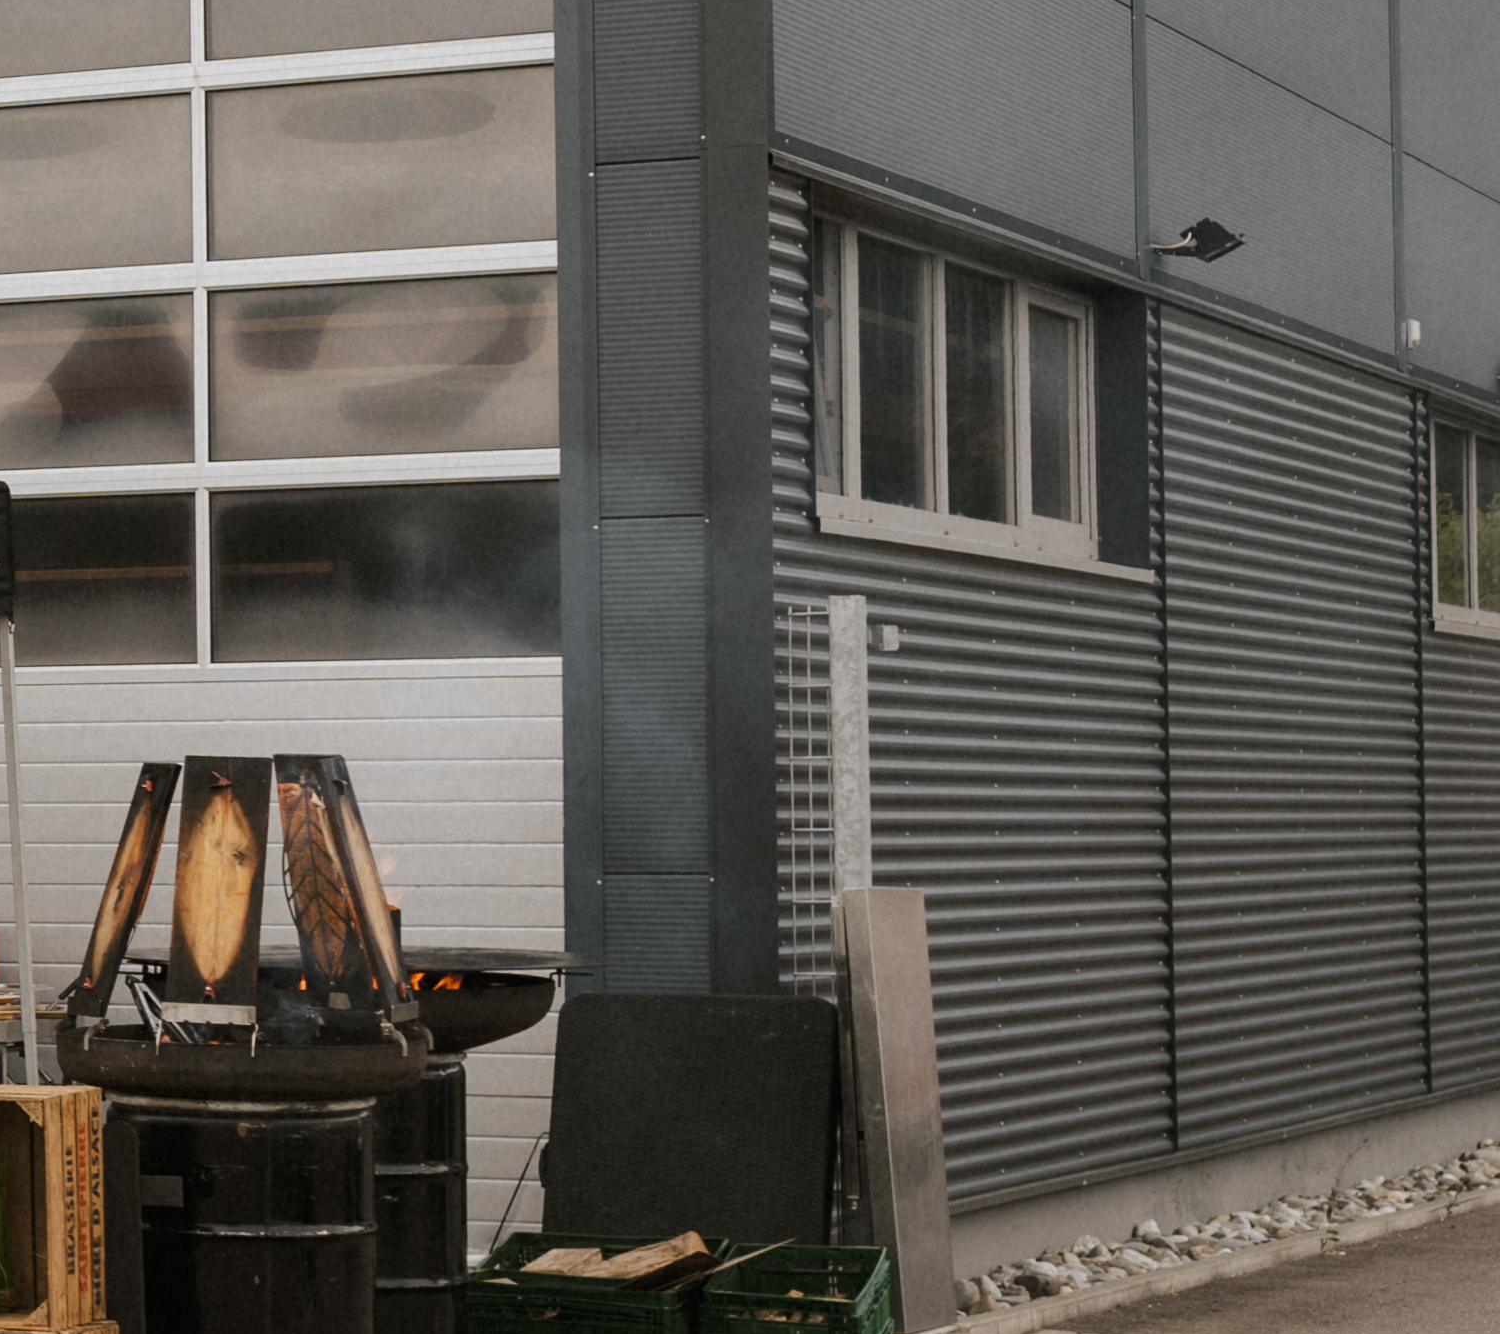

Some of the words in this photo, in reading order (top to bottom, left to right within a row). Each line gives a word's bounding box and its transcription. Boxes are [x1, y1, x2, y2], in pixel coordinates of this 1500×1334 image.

[65, 1145, 75, 1275] BRASSERIE
[78, 1121, 88, 1293] SAINT-PIERRE
[91, 1106, 101, 1225] D'ALSACE
